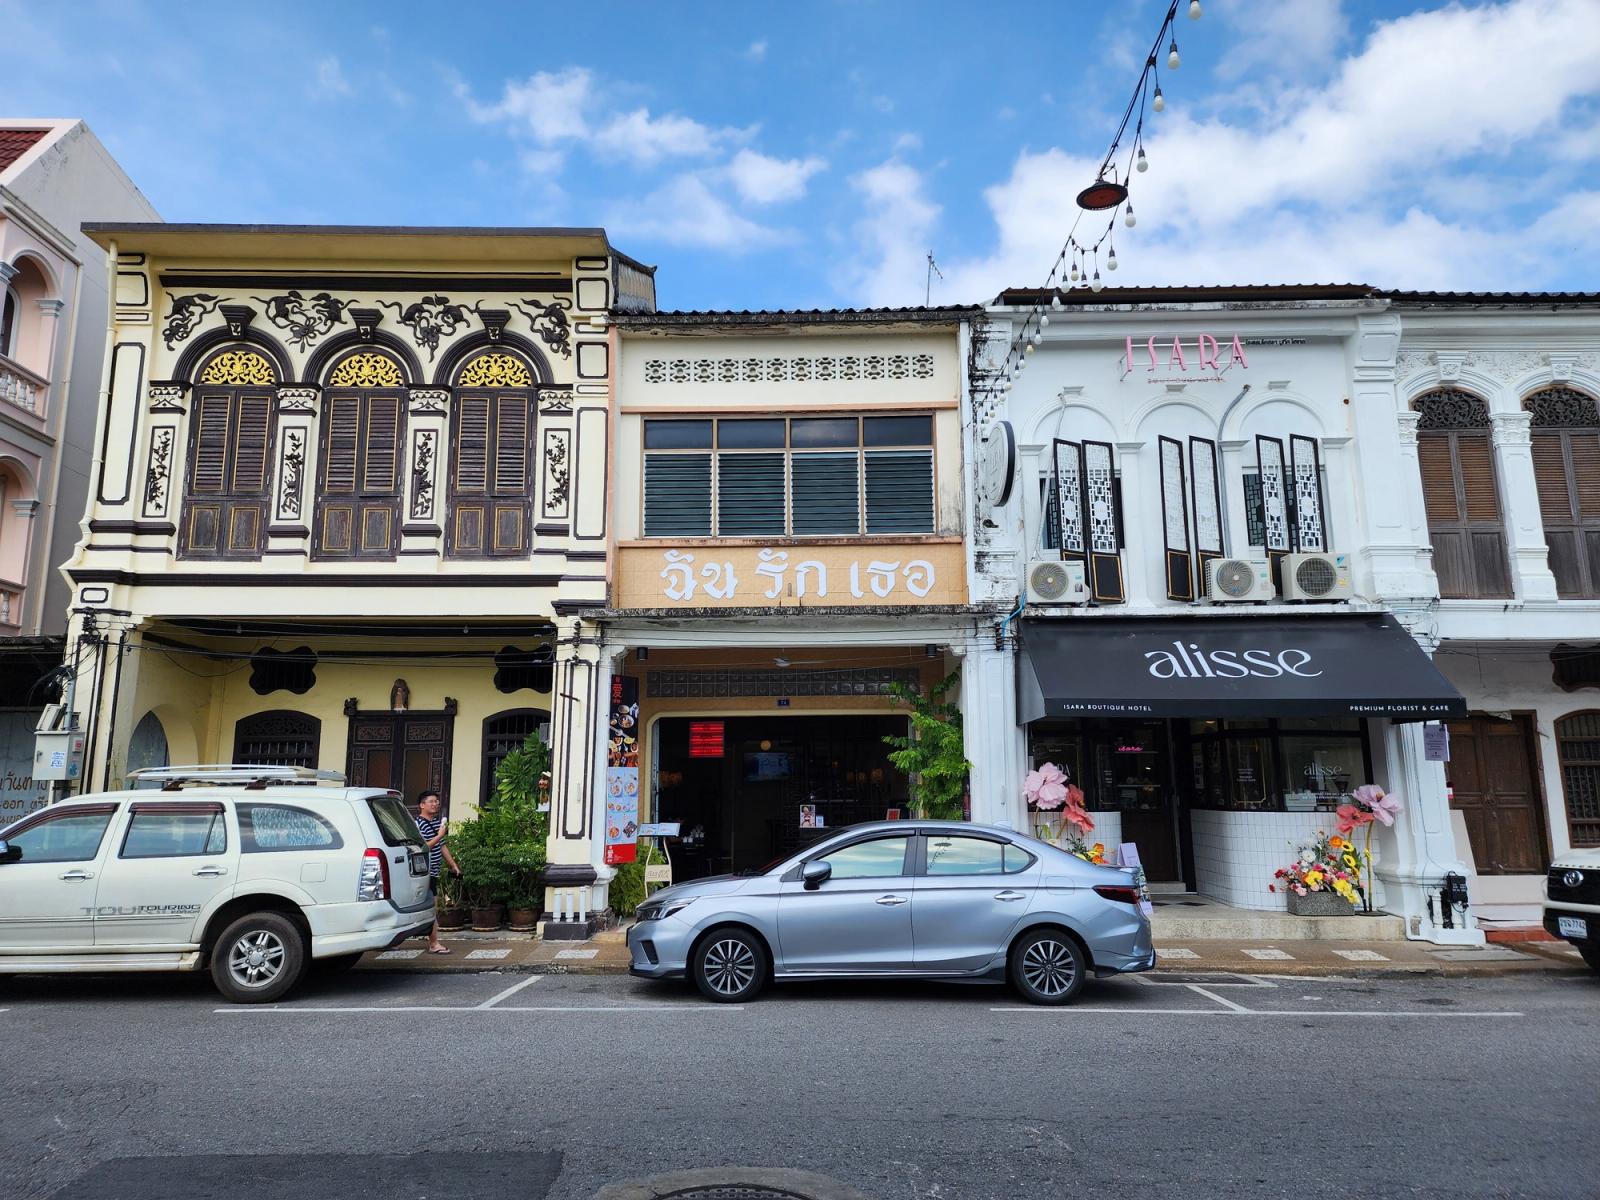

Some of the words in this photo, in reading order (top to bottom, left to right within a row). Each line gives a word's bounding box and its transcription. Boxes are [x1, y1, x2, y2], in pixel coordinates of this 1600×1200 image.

[1126, 333, 1248, 372] ISARA
[660, 549, 738, 600] ฉัน
[755, 548, 828, 598] รัก
[849, 559, 935, 599] เธอ
[1144, 640, 1323, 679] alisse
